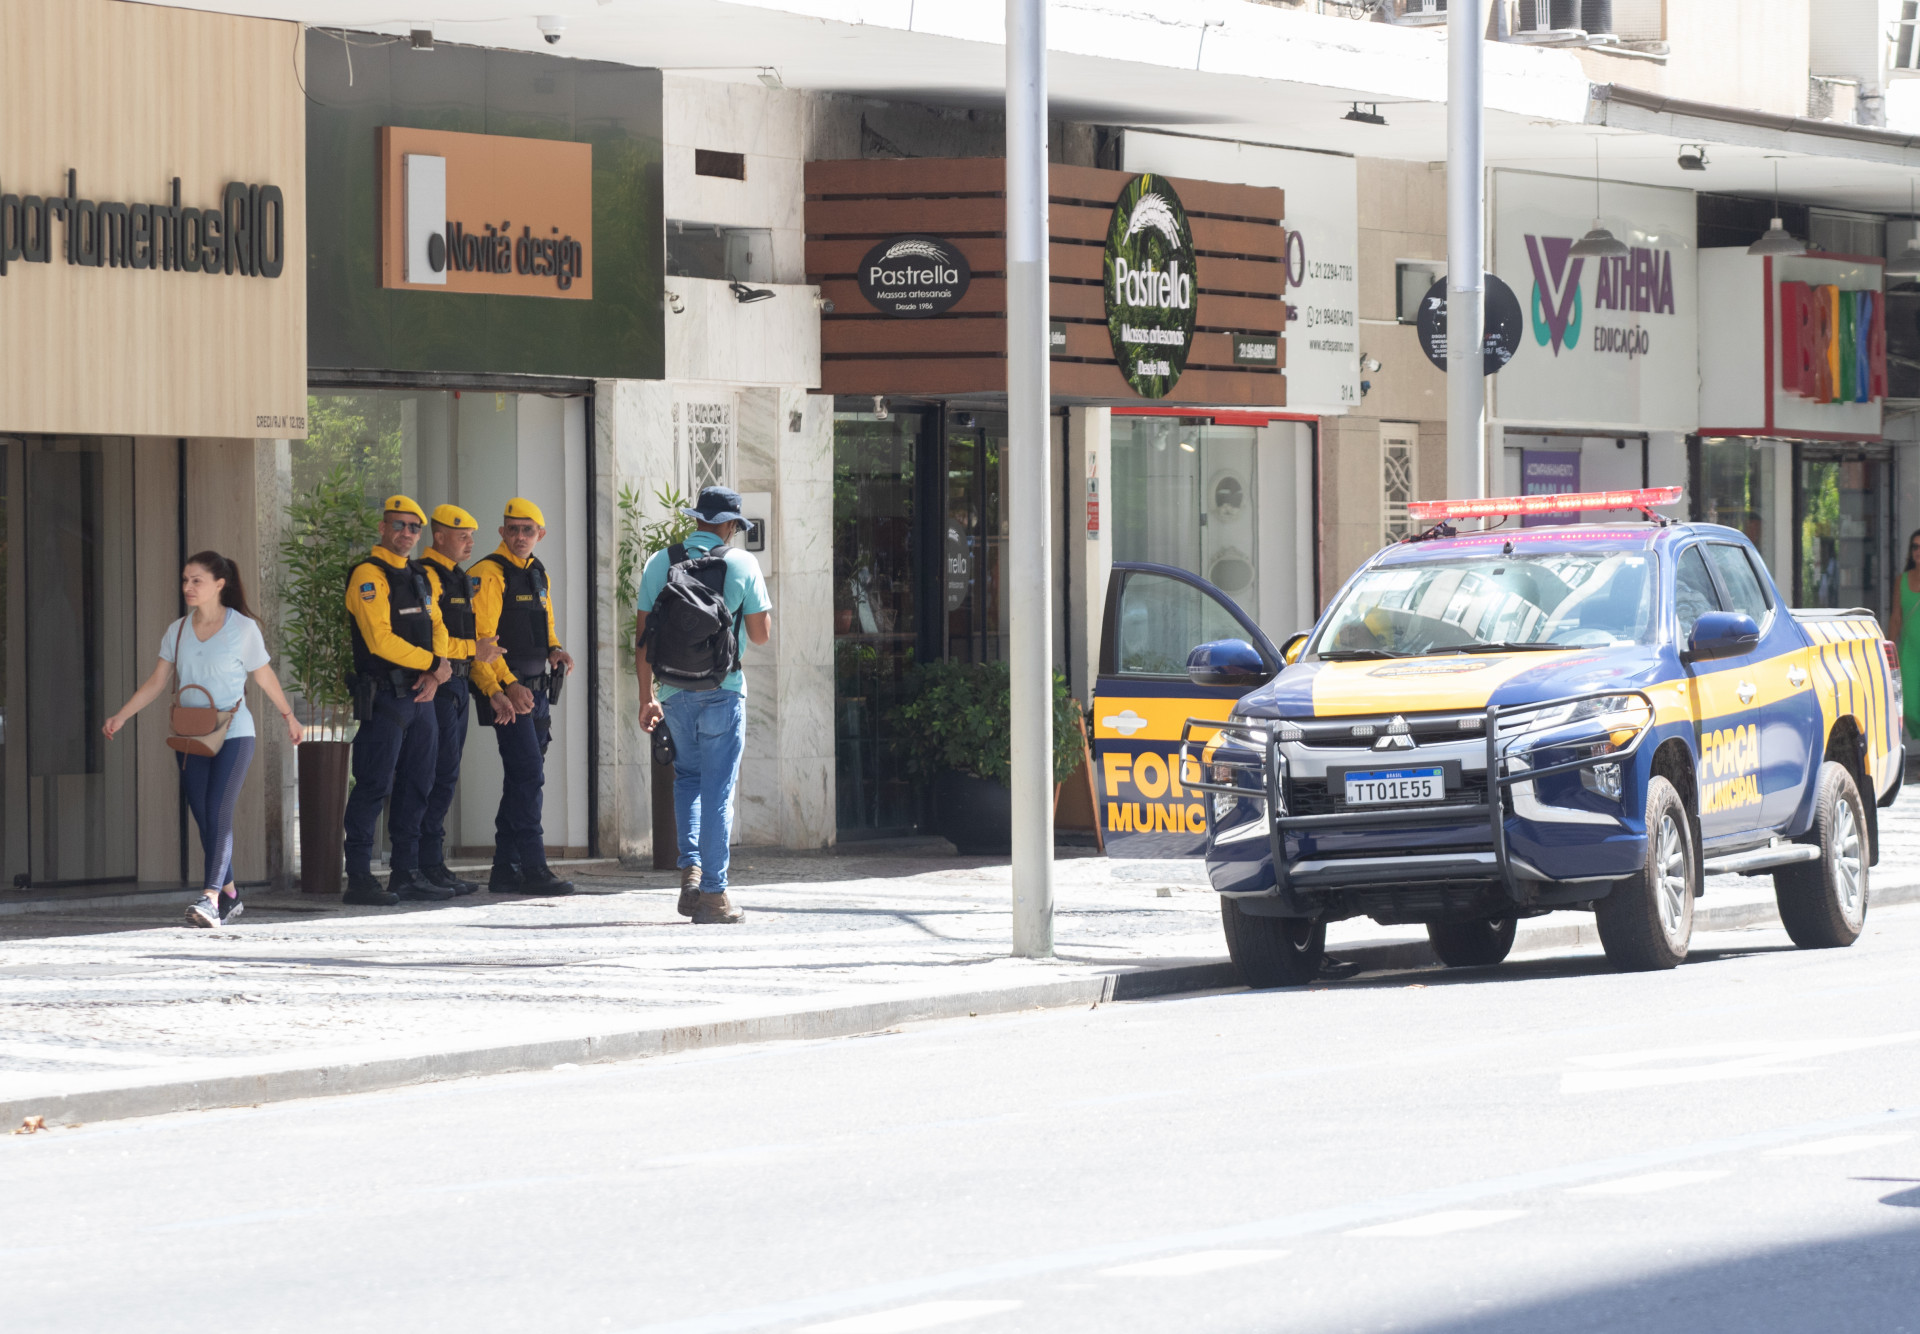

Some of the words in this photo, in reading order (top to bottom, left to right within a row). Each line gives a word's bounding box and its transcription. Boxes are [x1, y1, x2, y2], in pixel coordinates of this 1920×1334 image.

[0, 168, 284, 278] partamentosRIO
[446, 220, 512, 274] Novitá
[515, 225, 582, 290] design
[870, 265, 958, 286] Pastrella
[876, 290, 907, 299] Massas
[908, 288, 952, 299] artesanais
[1114, 256, 1190, 310] Pastrella
[1595, 246, 1675, 315] ATHENA
[895, 303, 917, 311] Desde
[918, 302, 933, 310] 1986
[1121, 323, 1149, 344] Massas
[1149, 324, 1185, 346] artesanais
[1594, 324, 1650, 360] EDUCAÇÃO
[1137, 359, 1157, 375] Desde
[948, 553, 967, 574] trella
[1701, 723, 1759, 780] FORÇA
[1102, 751, 1205, 799] FOR
[1701, 773, 1763, 815] MUNICIPAL
[1107, 802, 1207, 835] MUNIC
